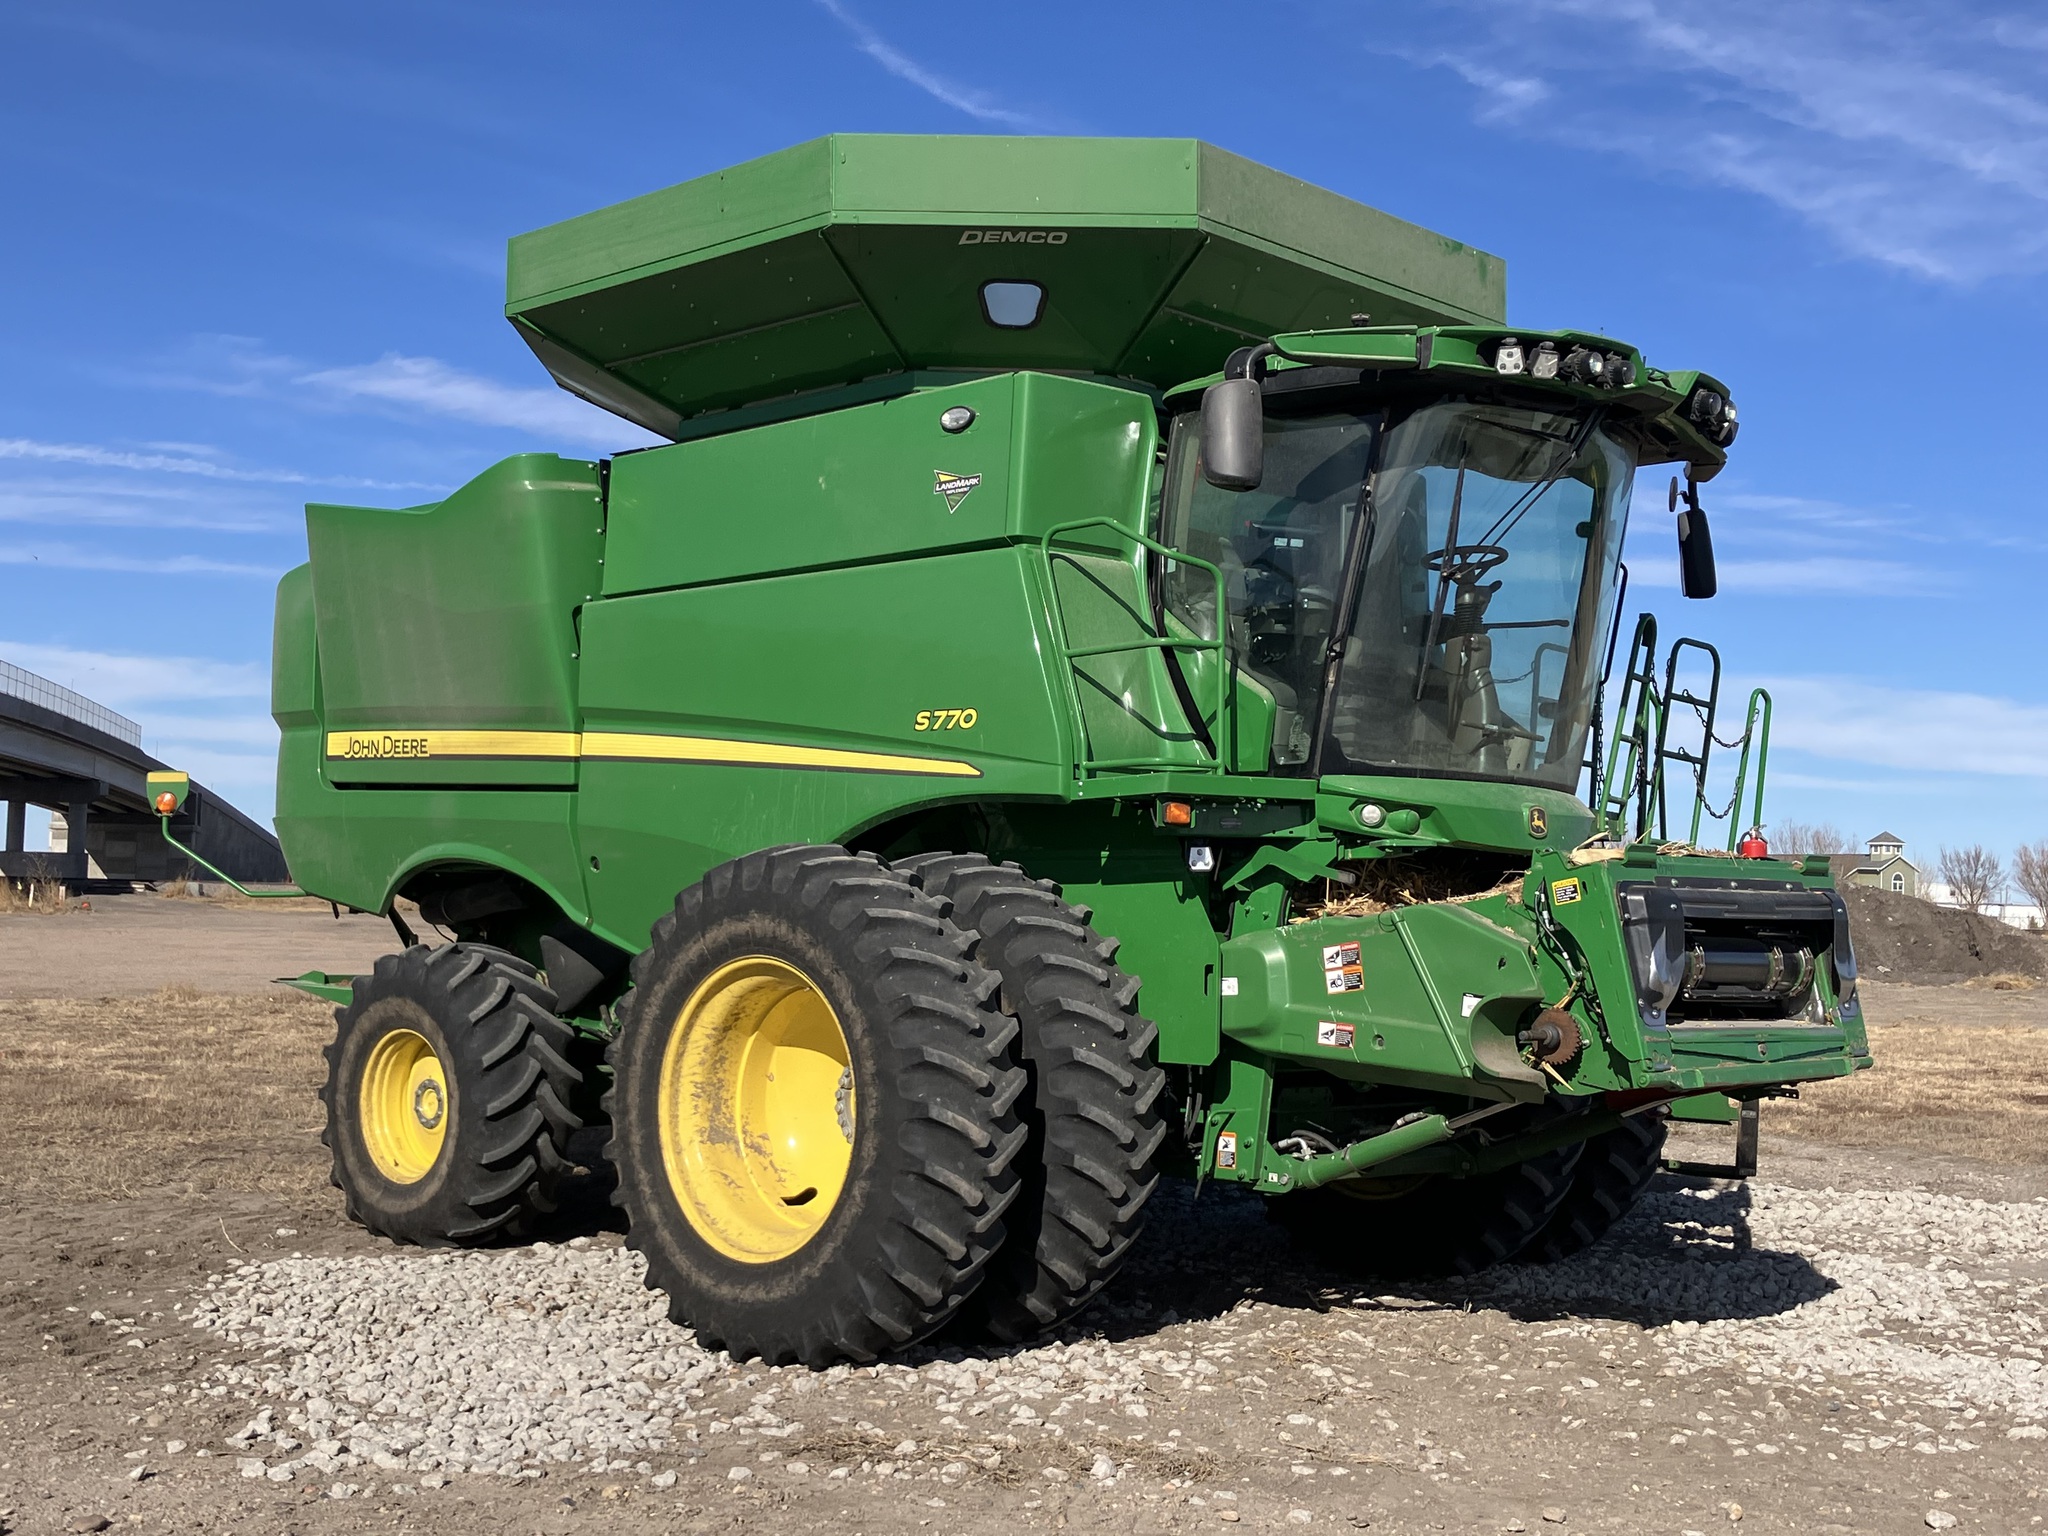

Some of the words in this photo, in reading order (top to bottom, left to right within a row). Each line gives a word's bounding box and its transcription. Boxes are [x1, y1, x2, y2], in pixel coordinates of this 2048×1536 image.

[958, 230, 1068, 245] DEMCO
[935, 477, 980, 491] LANDMARK
[914, 708, 978, 731] S770
[344, 736, 380, 755] JOHN
[383, 735, 428, 755] DEERE
